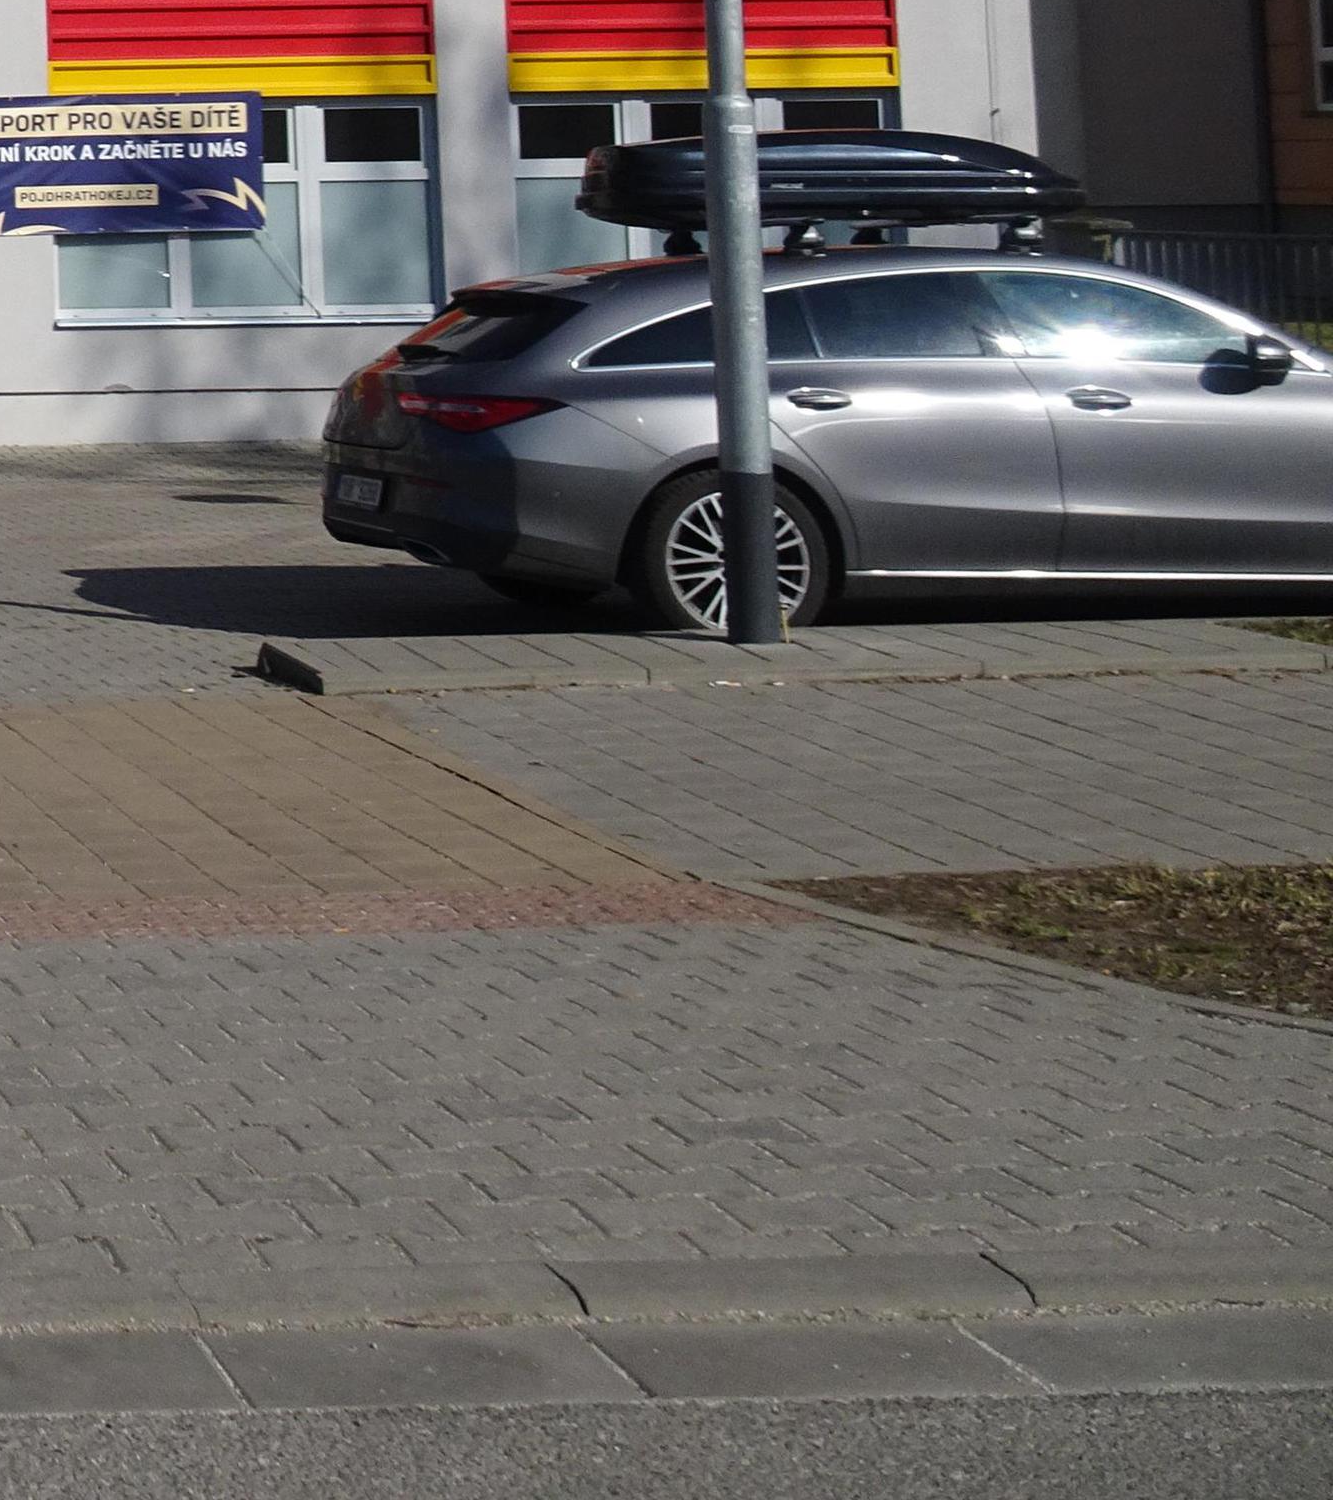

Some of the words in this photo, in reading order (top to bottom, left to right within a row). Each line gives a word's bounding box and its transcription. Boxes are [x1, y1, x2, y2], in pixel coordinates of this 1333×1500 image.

[68, 112, 112, 130] PRO
[121, 107, 181, 130] VAŠE
[191, 105, 241, 128] DÍTĚ
[25, 145, 76, 161] KROK
[80, 145, 95, 160] A
[98, 140, 185, 160] ZAČNĚTE
[189, 143, 203, 158] U
[207, 139, 248, 158] NÁS
[20, 190, 153, 203] POJDHRATHOKEJ.CZ
